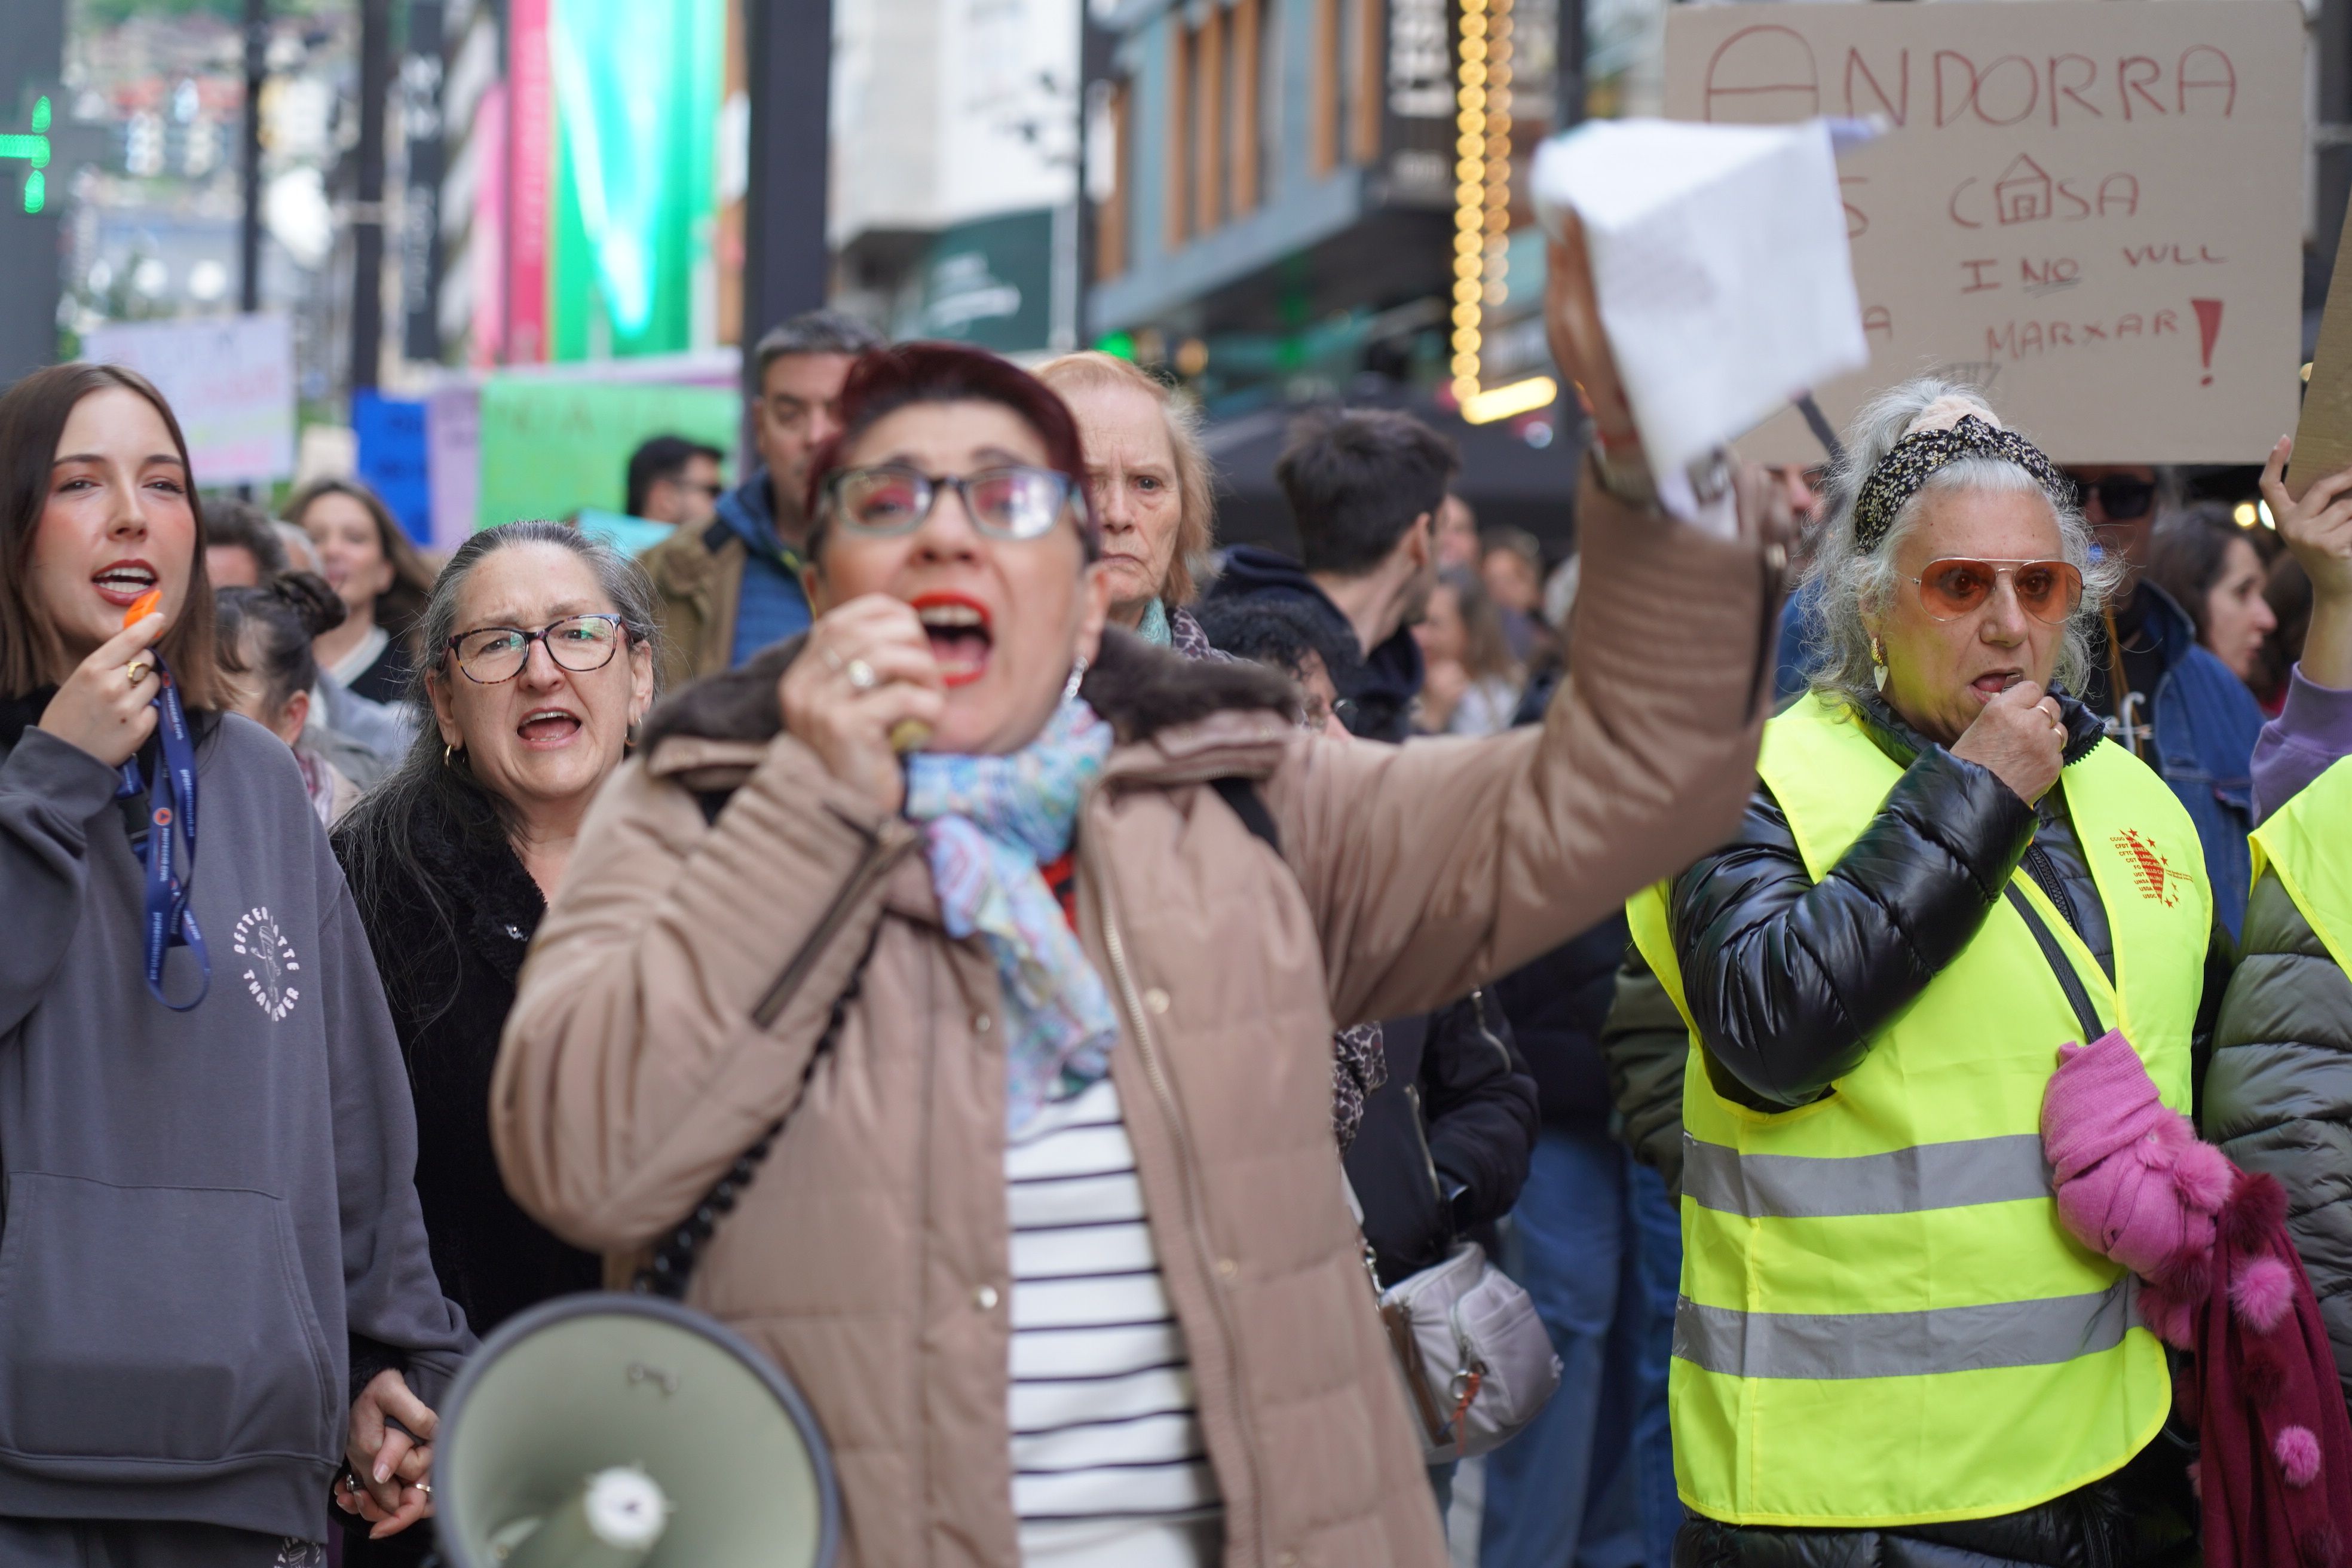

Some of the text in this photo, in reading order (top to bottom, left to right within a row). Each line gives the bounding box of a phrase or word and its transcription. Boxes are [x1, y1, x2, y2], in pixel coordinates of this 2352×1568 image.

[1705, 24, 2237, 127] ANDORRA
[1961, 243, 2229, 293] I NO VULL
[234, 906, 268, 954] BETTER
[243, 969, 271, 1014] THAN
